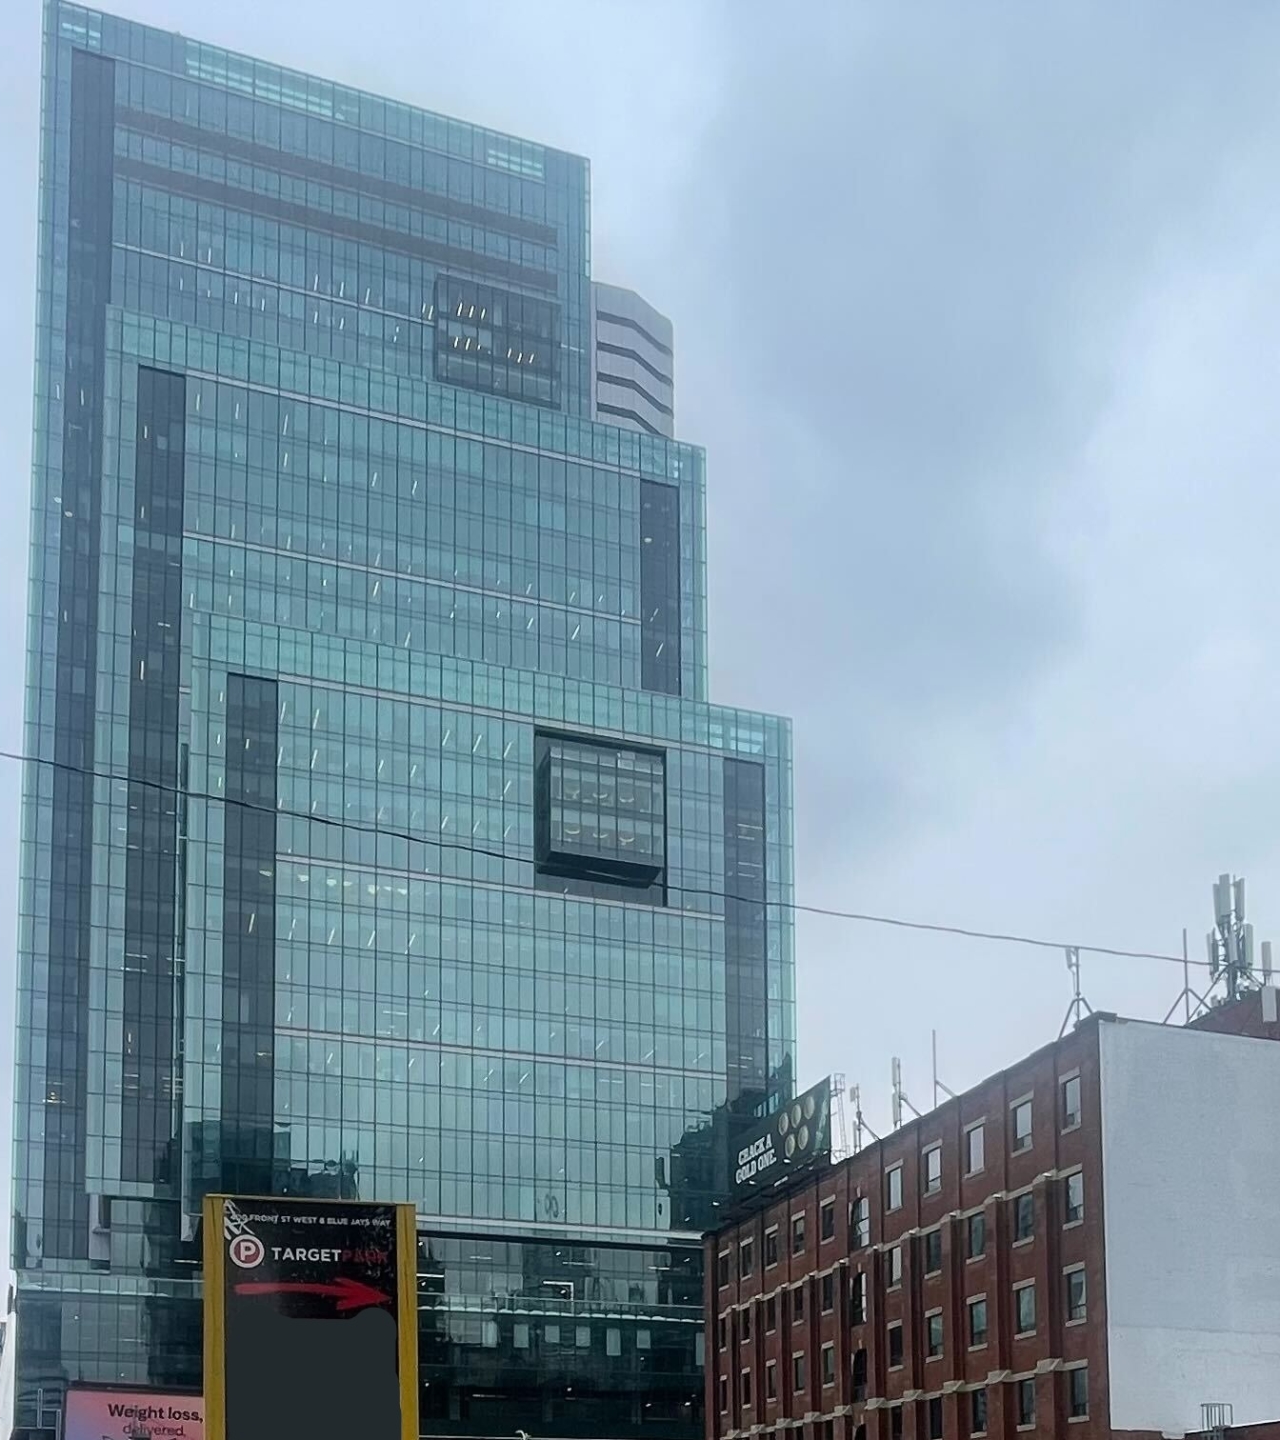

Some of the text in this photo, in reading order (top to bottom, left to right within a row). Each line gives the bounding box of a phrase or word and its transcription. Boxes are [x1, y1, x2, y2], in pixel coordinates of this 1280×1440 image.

[280, 1215, 291, 1223] ST
[293, 1216, 318, 1224] WEST
[326, 1217, 348, 1225] BLUE
[350, 1218, 370, 1227] JAYS
[240, 1241, 257, 1260] P
[108, 1403, 204, 1423] Weight loss,
